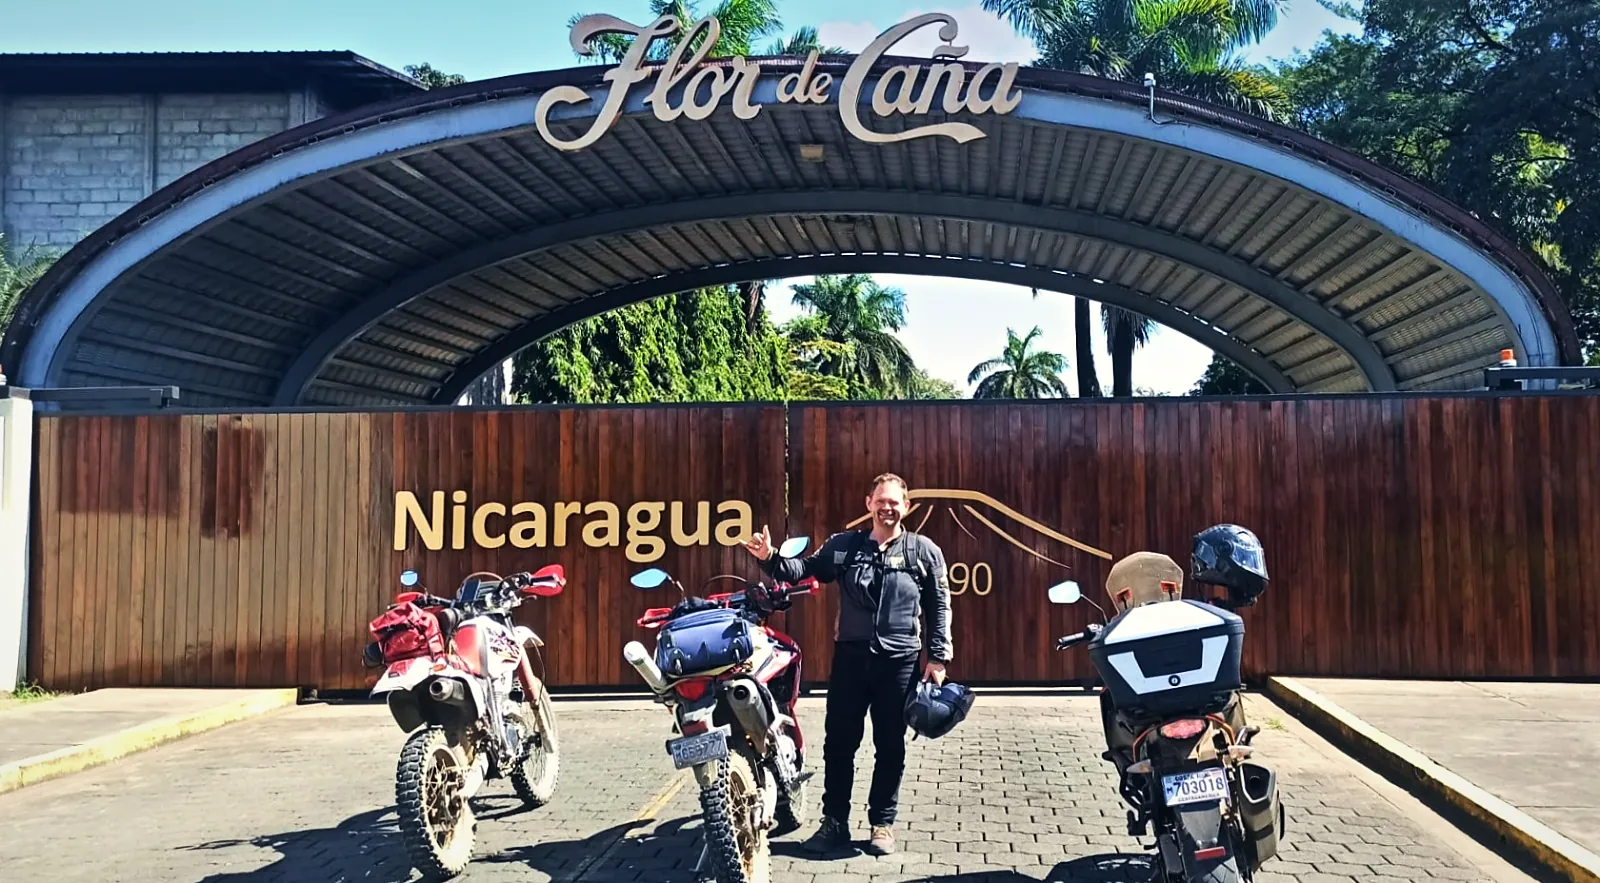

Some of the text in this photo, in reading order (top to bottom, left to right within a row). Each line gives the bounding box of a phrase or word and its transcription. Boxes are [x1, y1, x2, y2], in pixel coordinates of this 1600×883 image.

[535, 13, 1023, 152] Flor de Caña
[393, 490, 754, 563] Nicaragua
[1173, 777, 1224, 797] 703018
